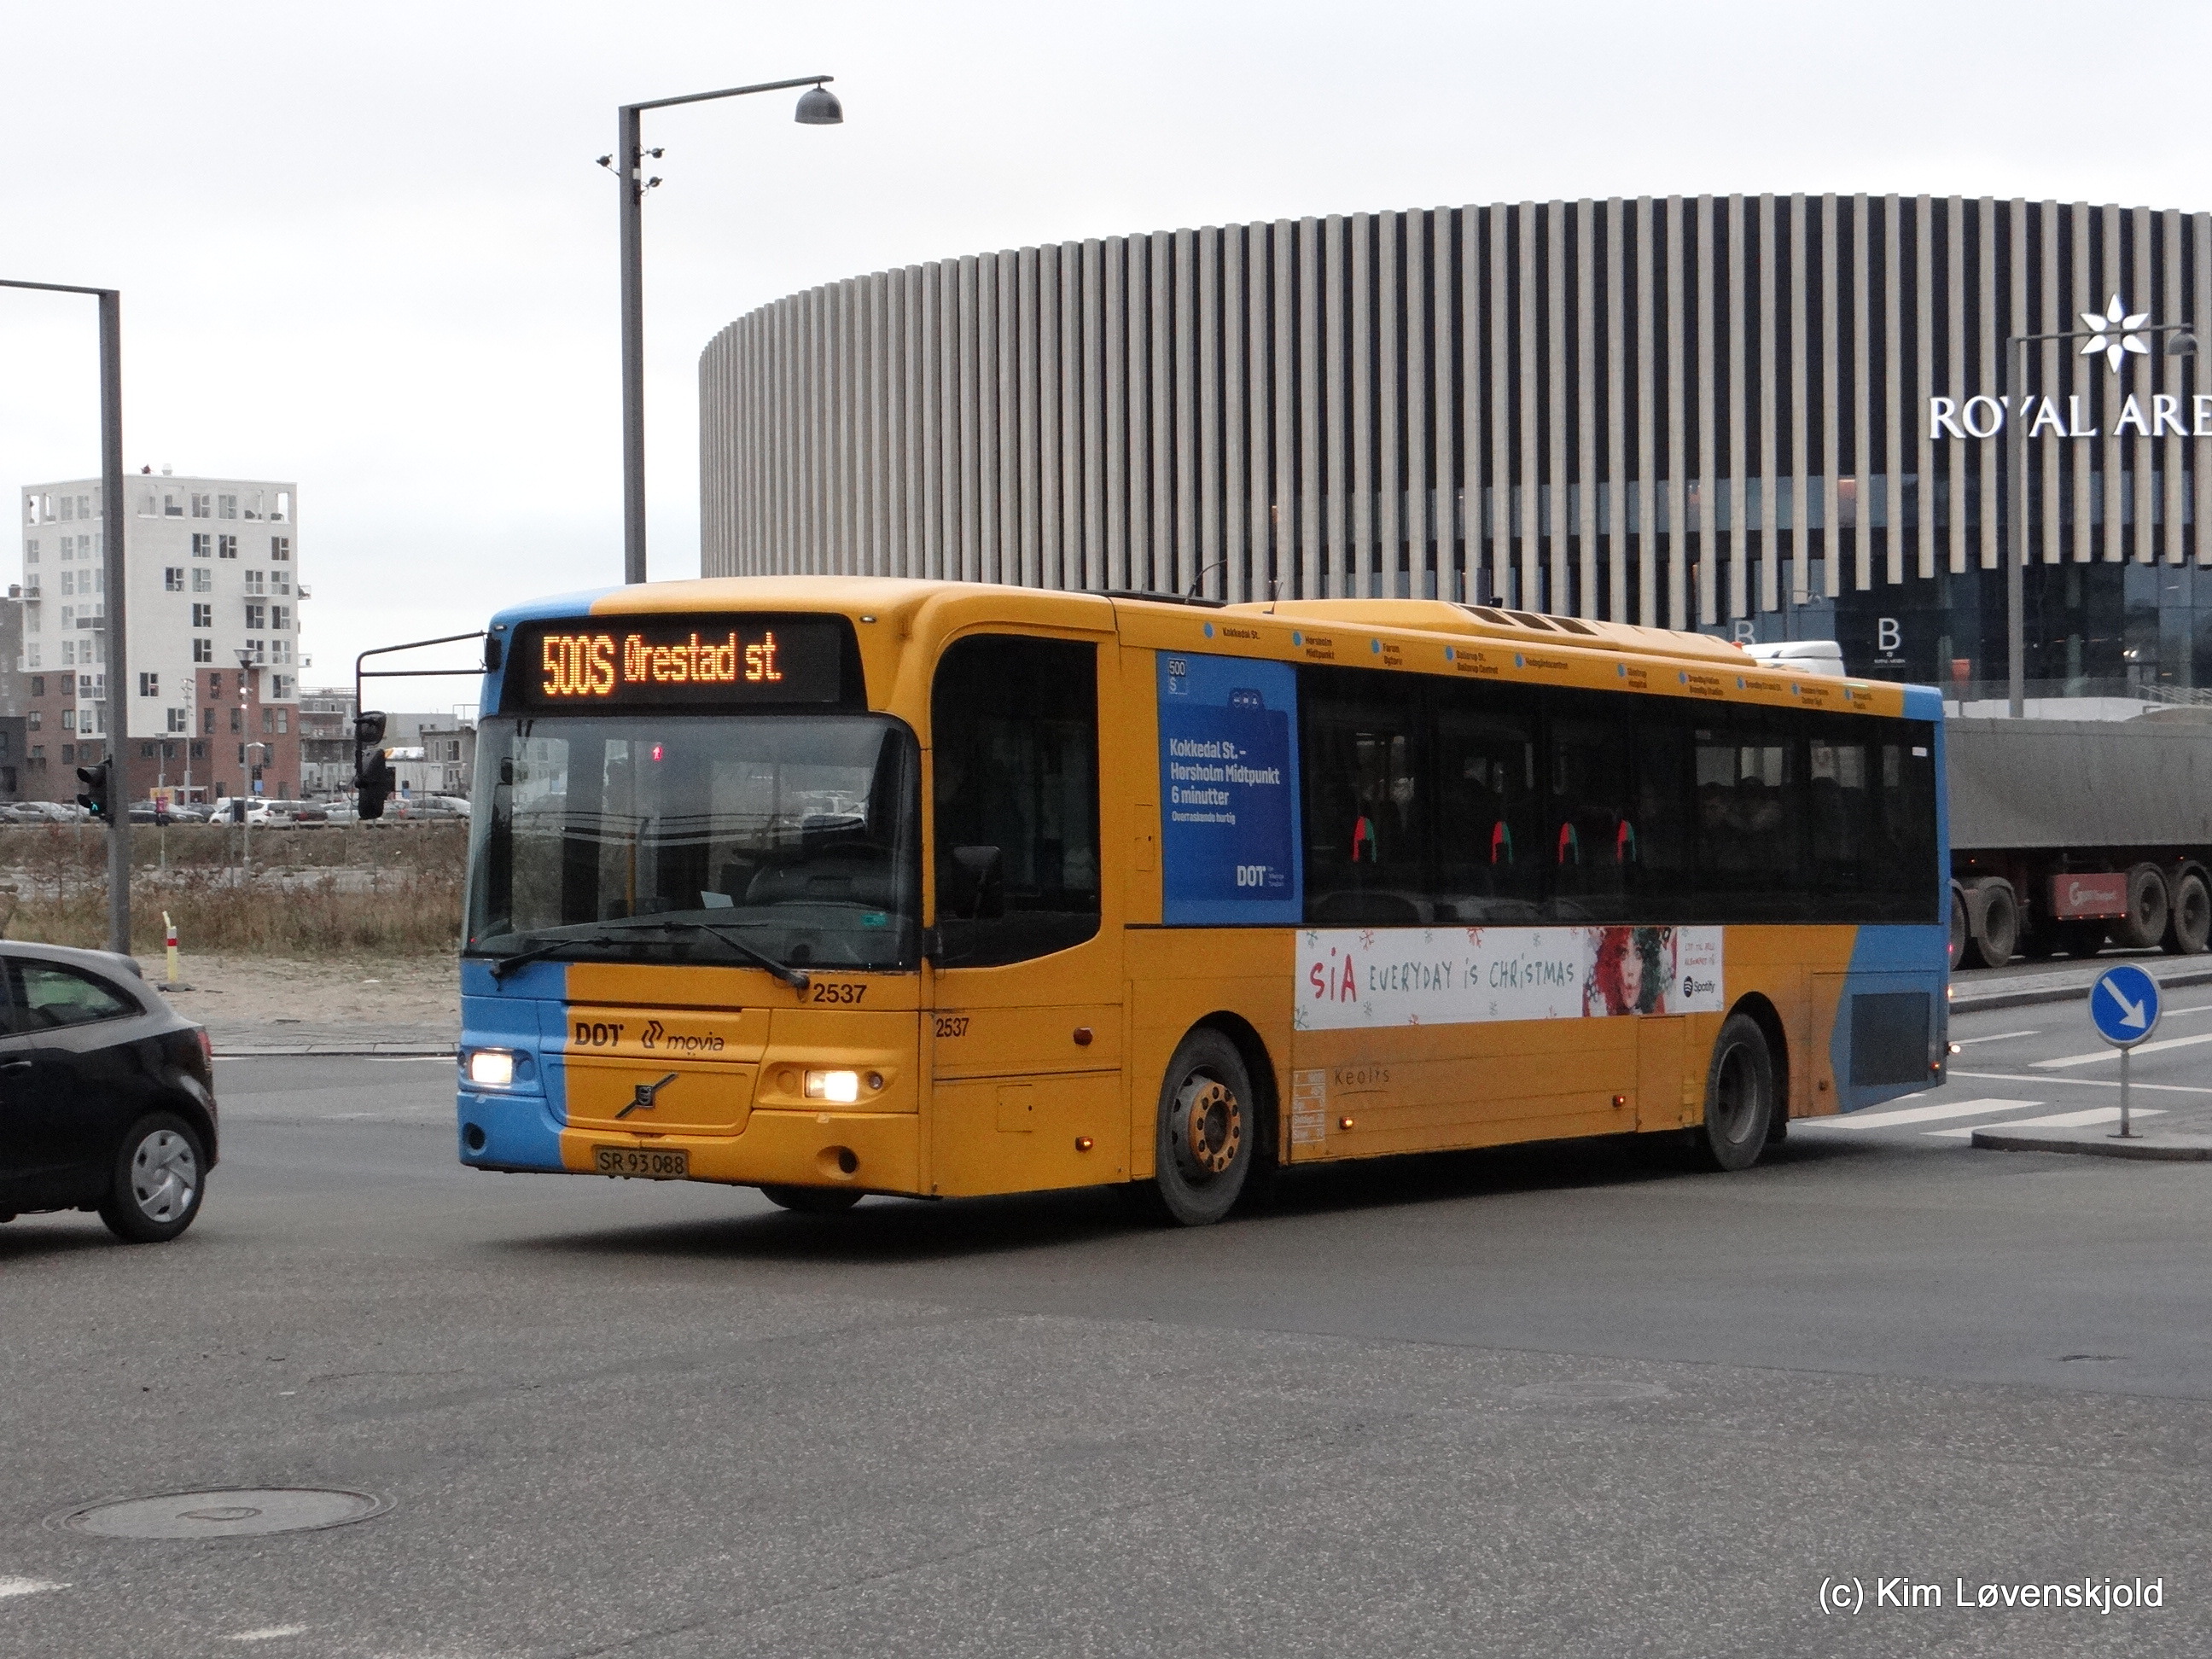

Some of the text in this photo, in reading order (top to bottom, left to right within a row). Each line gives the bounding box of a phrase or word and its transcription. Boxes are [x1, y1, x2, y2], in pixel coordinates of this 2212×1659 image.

[1878, 618, 1901, 650] B
[543, 632, 782, 695] 500S Ørestad st.
[1169, 661, 1185, 676] 500
[1169, 676, 1177, 692] S
[1170, 738, 1221, 759] Kokkedal
[1222, 741, 1237, 759] St.
[1170, 762, 1280, 787] Hørsholm Midtpunkt
[1171, 785, 1230, 806] 6 minutter
[1237, 864, 1266, 887] DOT
[813, 983, 867, 1004] 2537
[1693, 981, 1715, 993] Spotify
[574, 1022, 725, 1051] DOT movia
[935, 1017, 969, 1038] 2537
[1334, 1067, 1389, 1085] Keolis
[599, 1152, 684, 1174] SR 93 088
